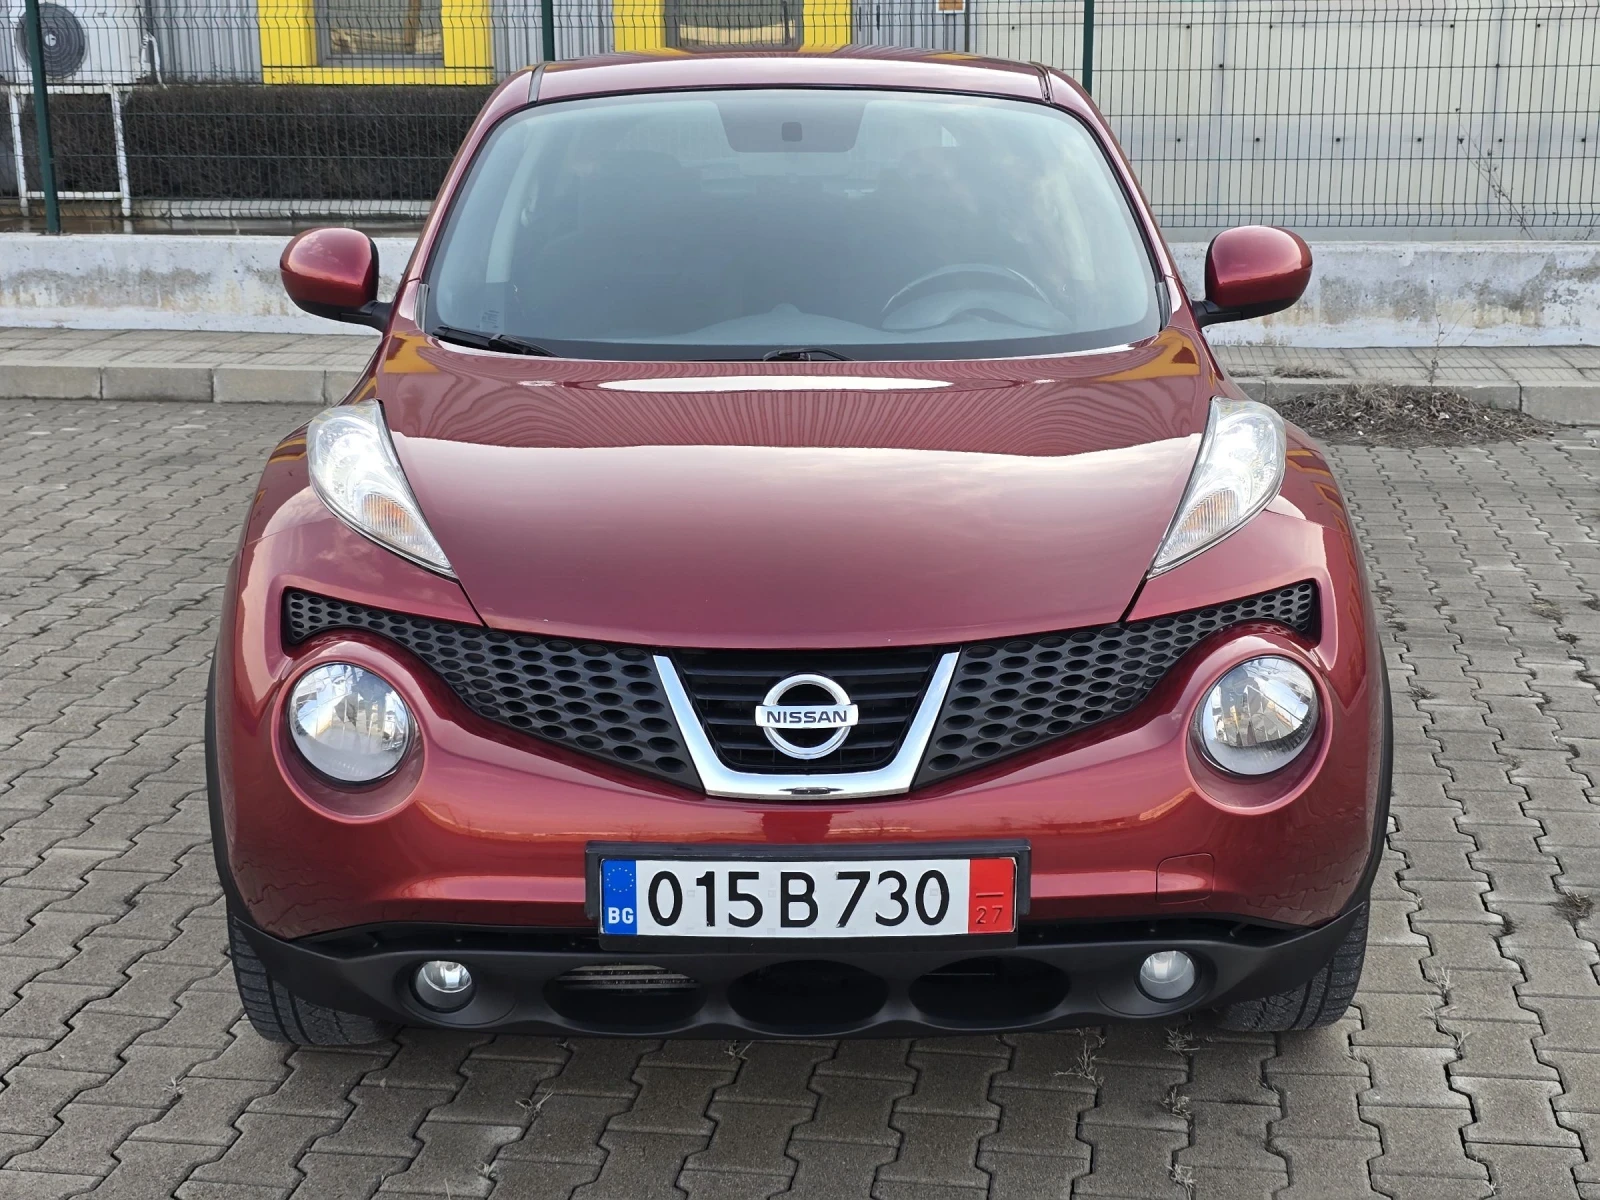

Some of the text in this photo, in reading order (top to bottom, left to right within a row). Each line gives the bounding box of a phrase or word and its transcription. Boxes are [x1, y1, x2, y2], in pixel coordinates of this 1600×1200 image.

[766, 710, 847, 724] NISSAN
[608, 907, 634, 924] BG
[975, 905, 1004, 924] 27
